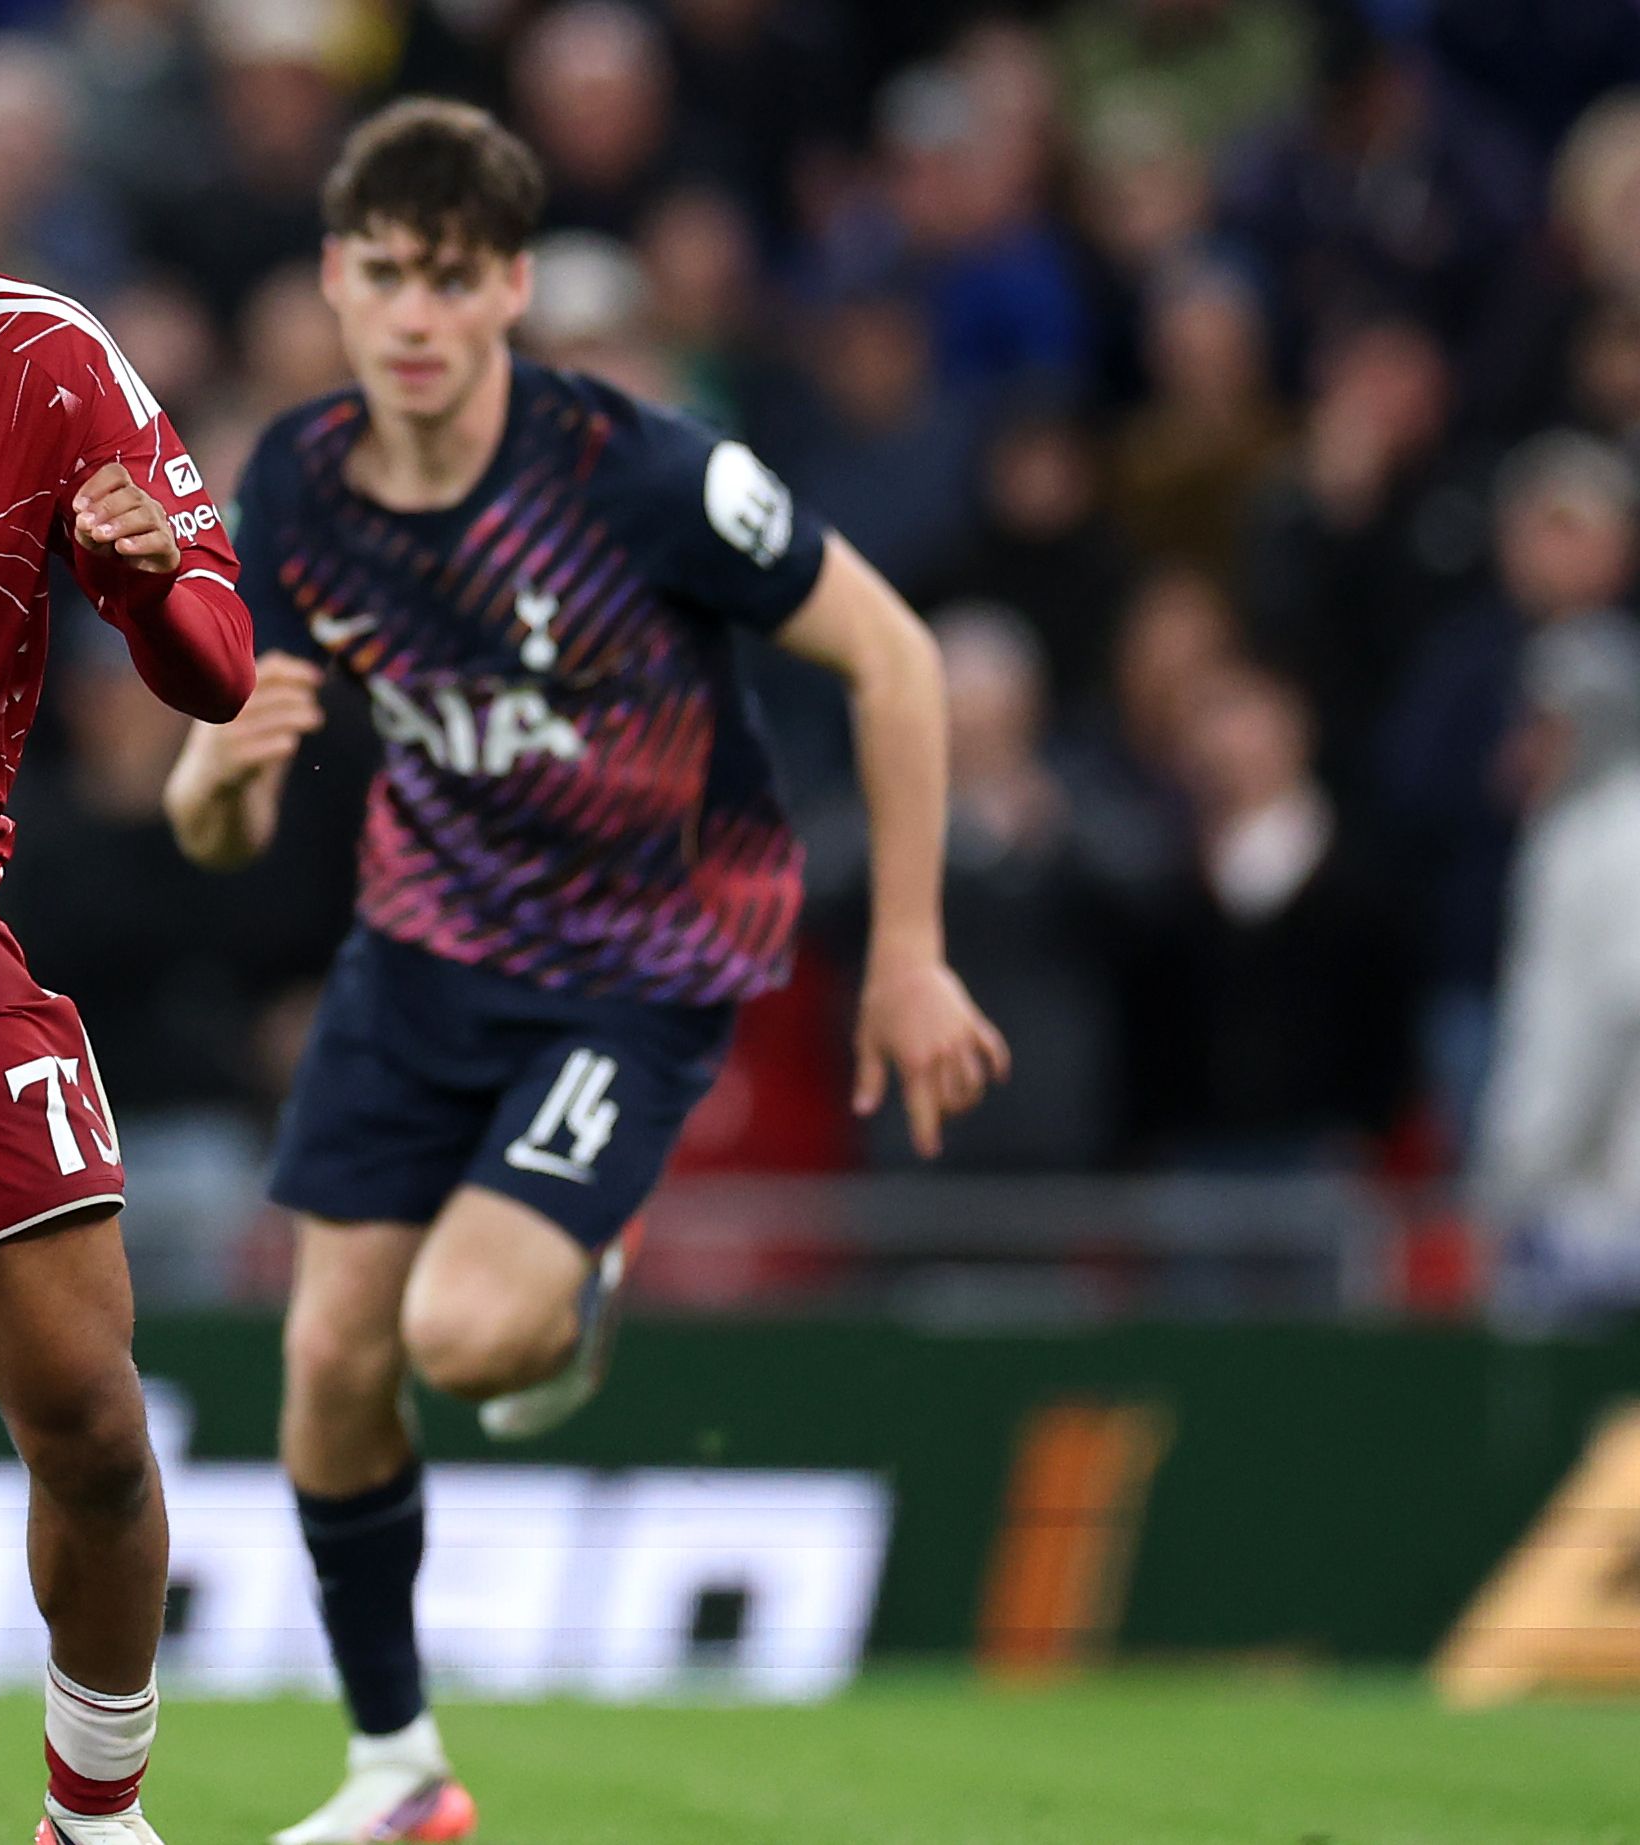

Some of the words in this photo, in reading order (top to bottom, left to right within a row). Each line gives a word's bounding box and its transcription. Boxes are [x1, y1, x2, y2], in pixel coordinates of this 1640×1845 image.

[168, 504, 222, 542] xpe
[367, 675, 588, 776] AIA
[504, 1047, 620, 1185] 14
